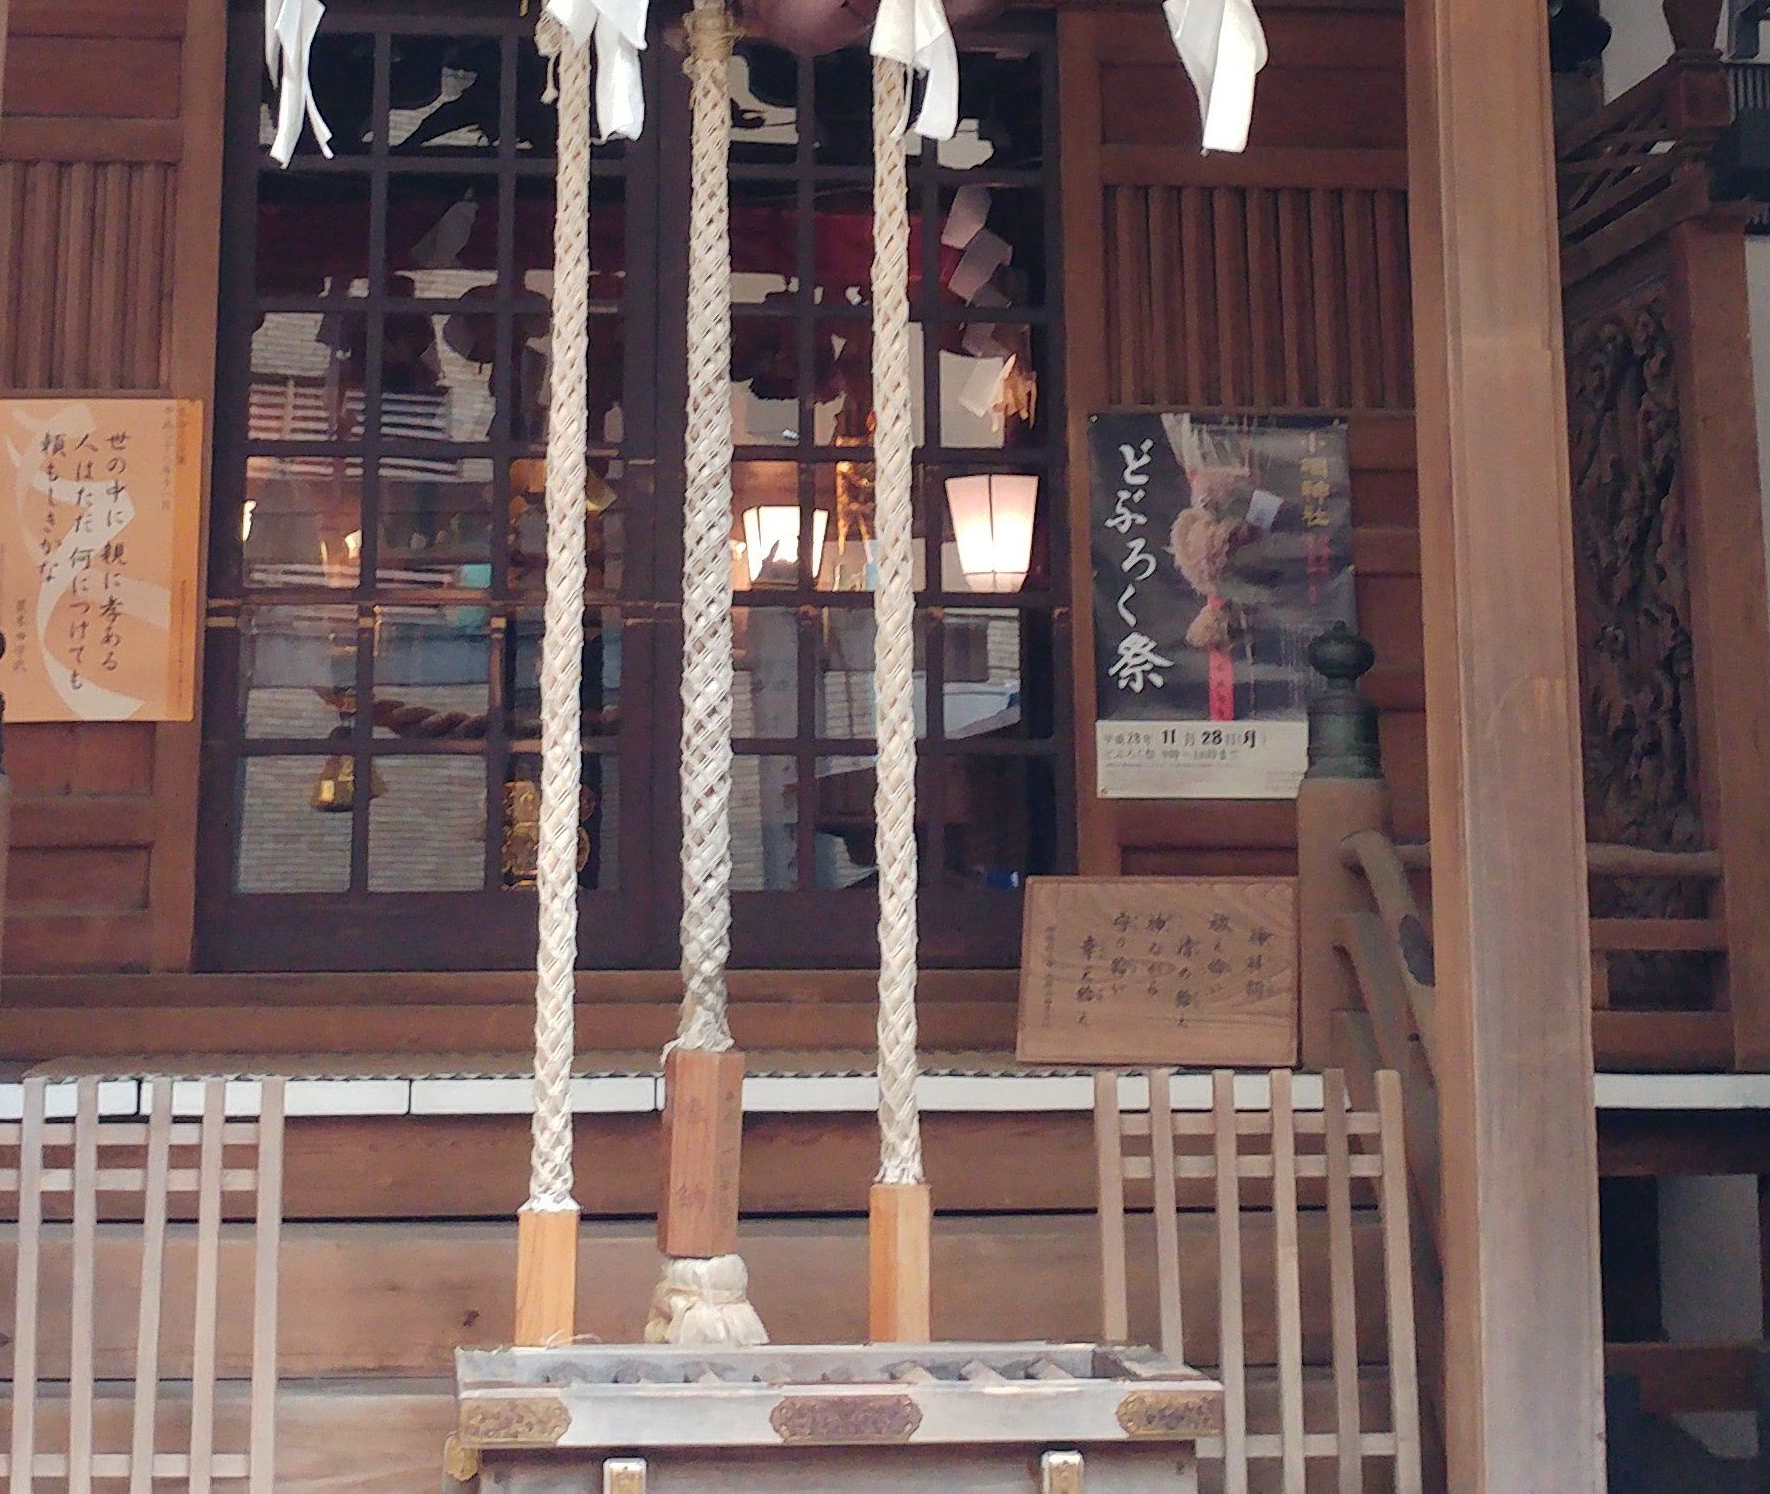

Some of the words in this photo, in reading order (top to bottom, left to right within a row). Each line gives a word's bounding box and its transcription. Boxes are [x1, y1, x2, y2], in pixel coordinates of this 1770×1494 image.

[1103, 437, 1175, 694] どぶろく祭
